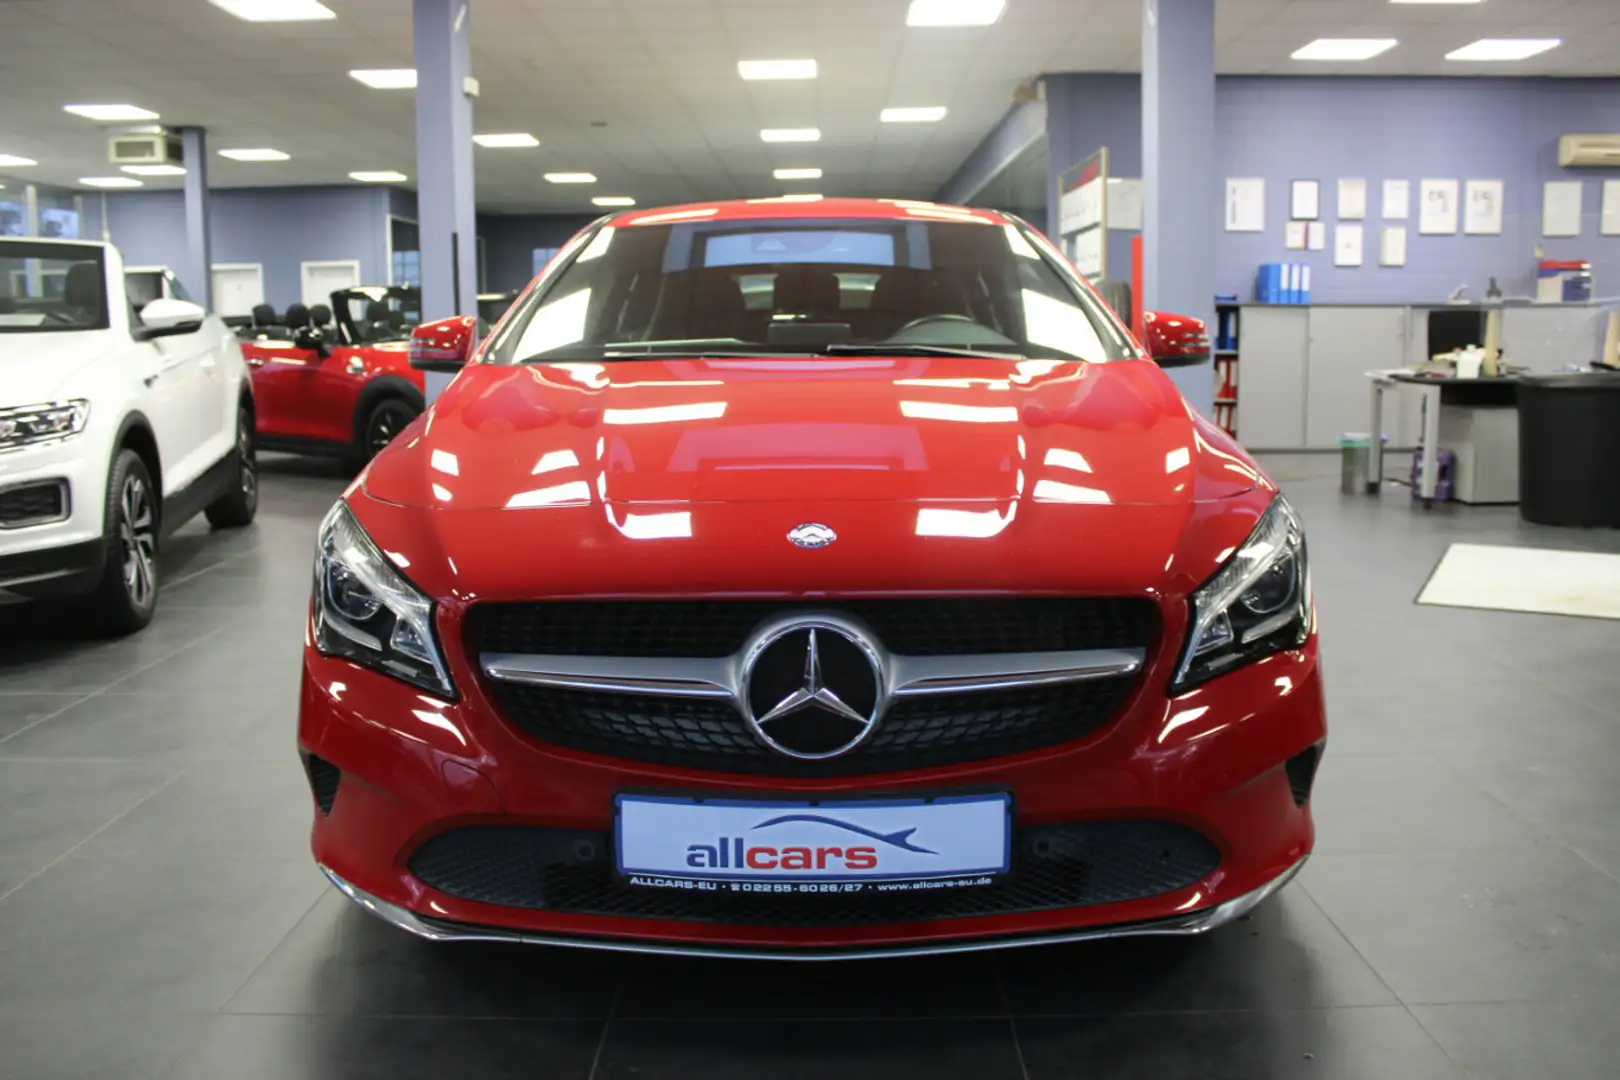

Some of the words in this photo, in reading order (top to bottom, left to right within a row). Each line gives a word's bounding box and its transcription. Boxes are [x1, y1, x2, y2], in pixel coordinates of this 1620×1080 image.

[686, 836, 878, 870] allcars
[629, 876, 717, 890] ALLCARS-EU
[877, 877, 992, 891] www.allcars-eu.de
